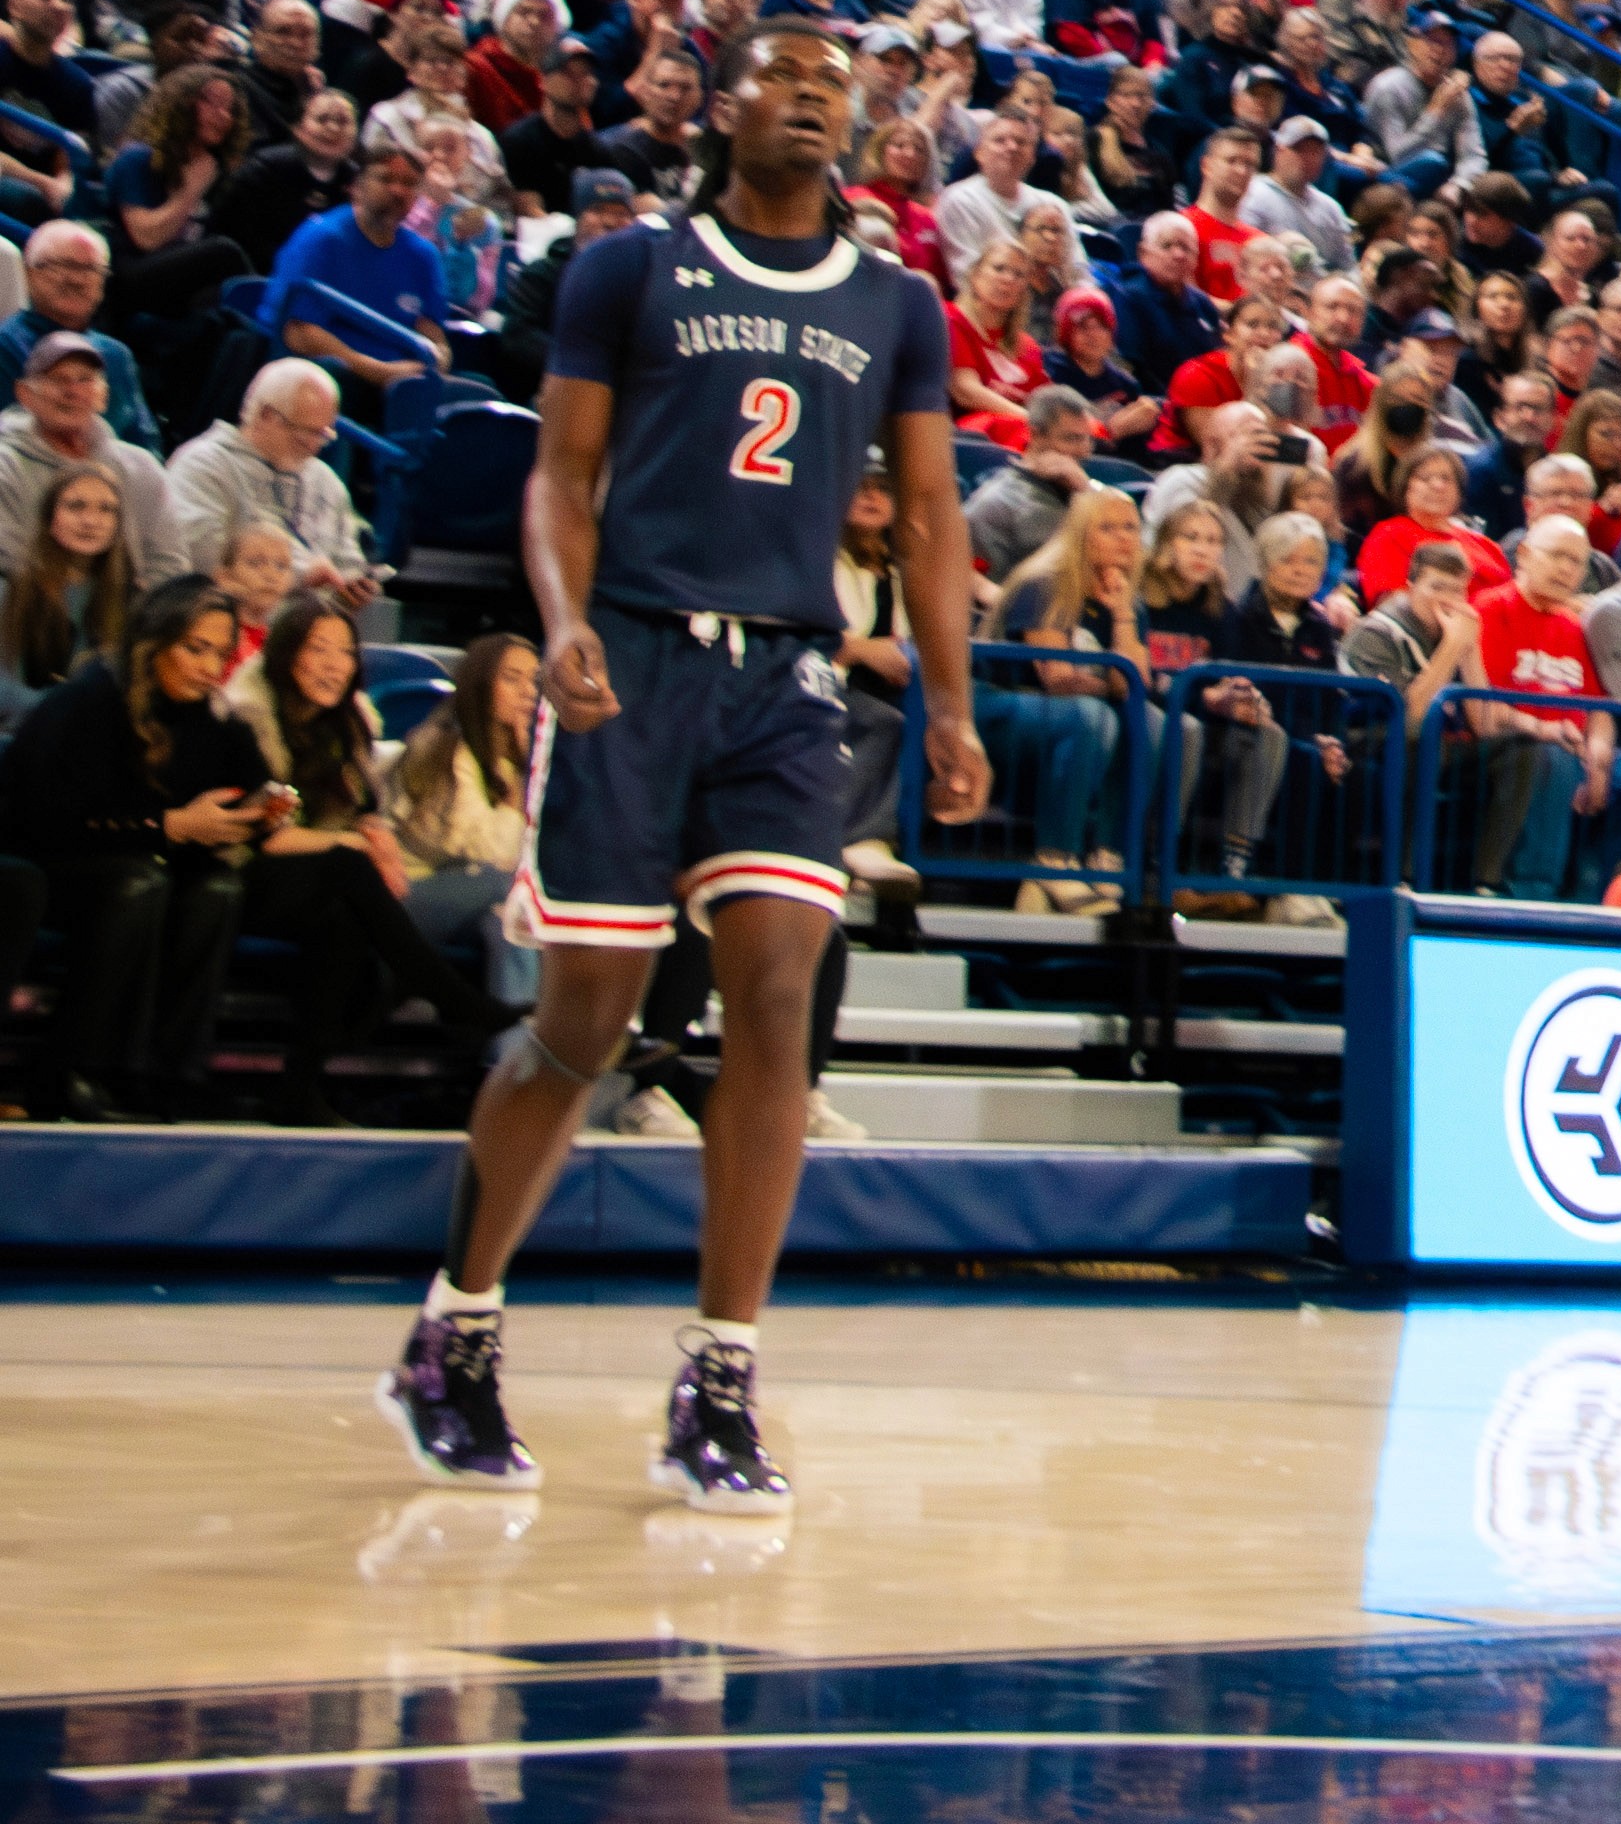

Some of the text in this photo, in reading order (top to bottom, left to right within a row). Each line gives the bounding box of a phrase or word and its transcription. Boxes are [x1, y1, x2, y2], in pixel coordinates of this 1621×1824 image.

[673, 314, 872, 385] JACKSON STATE
[729, 378, 801, 486] 2
